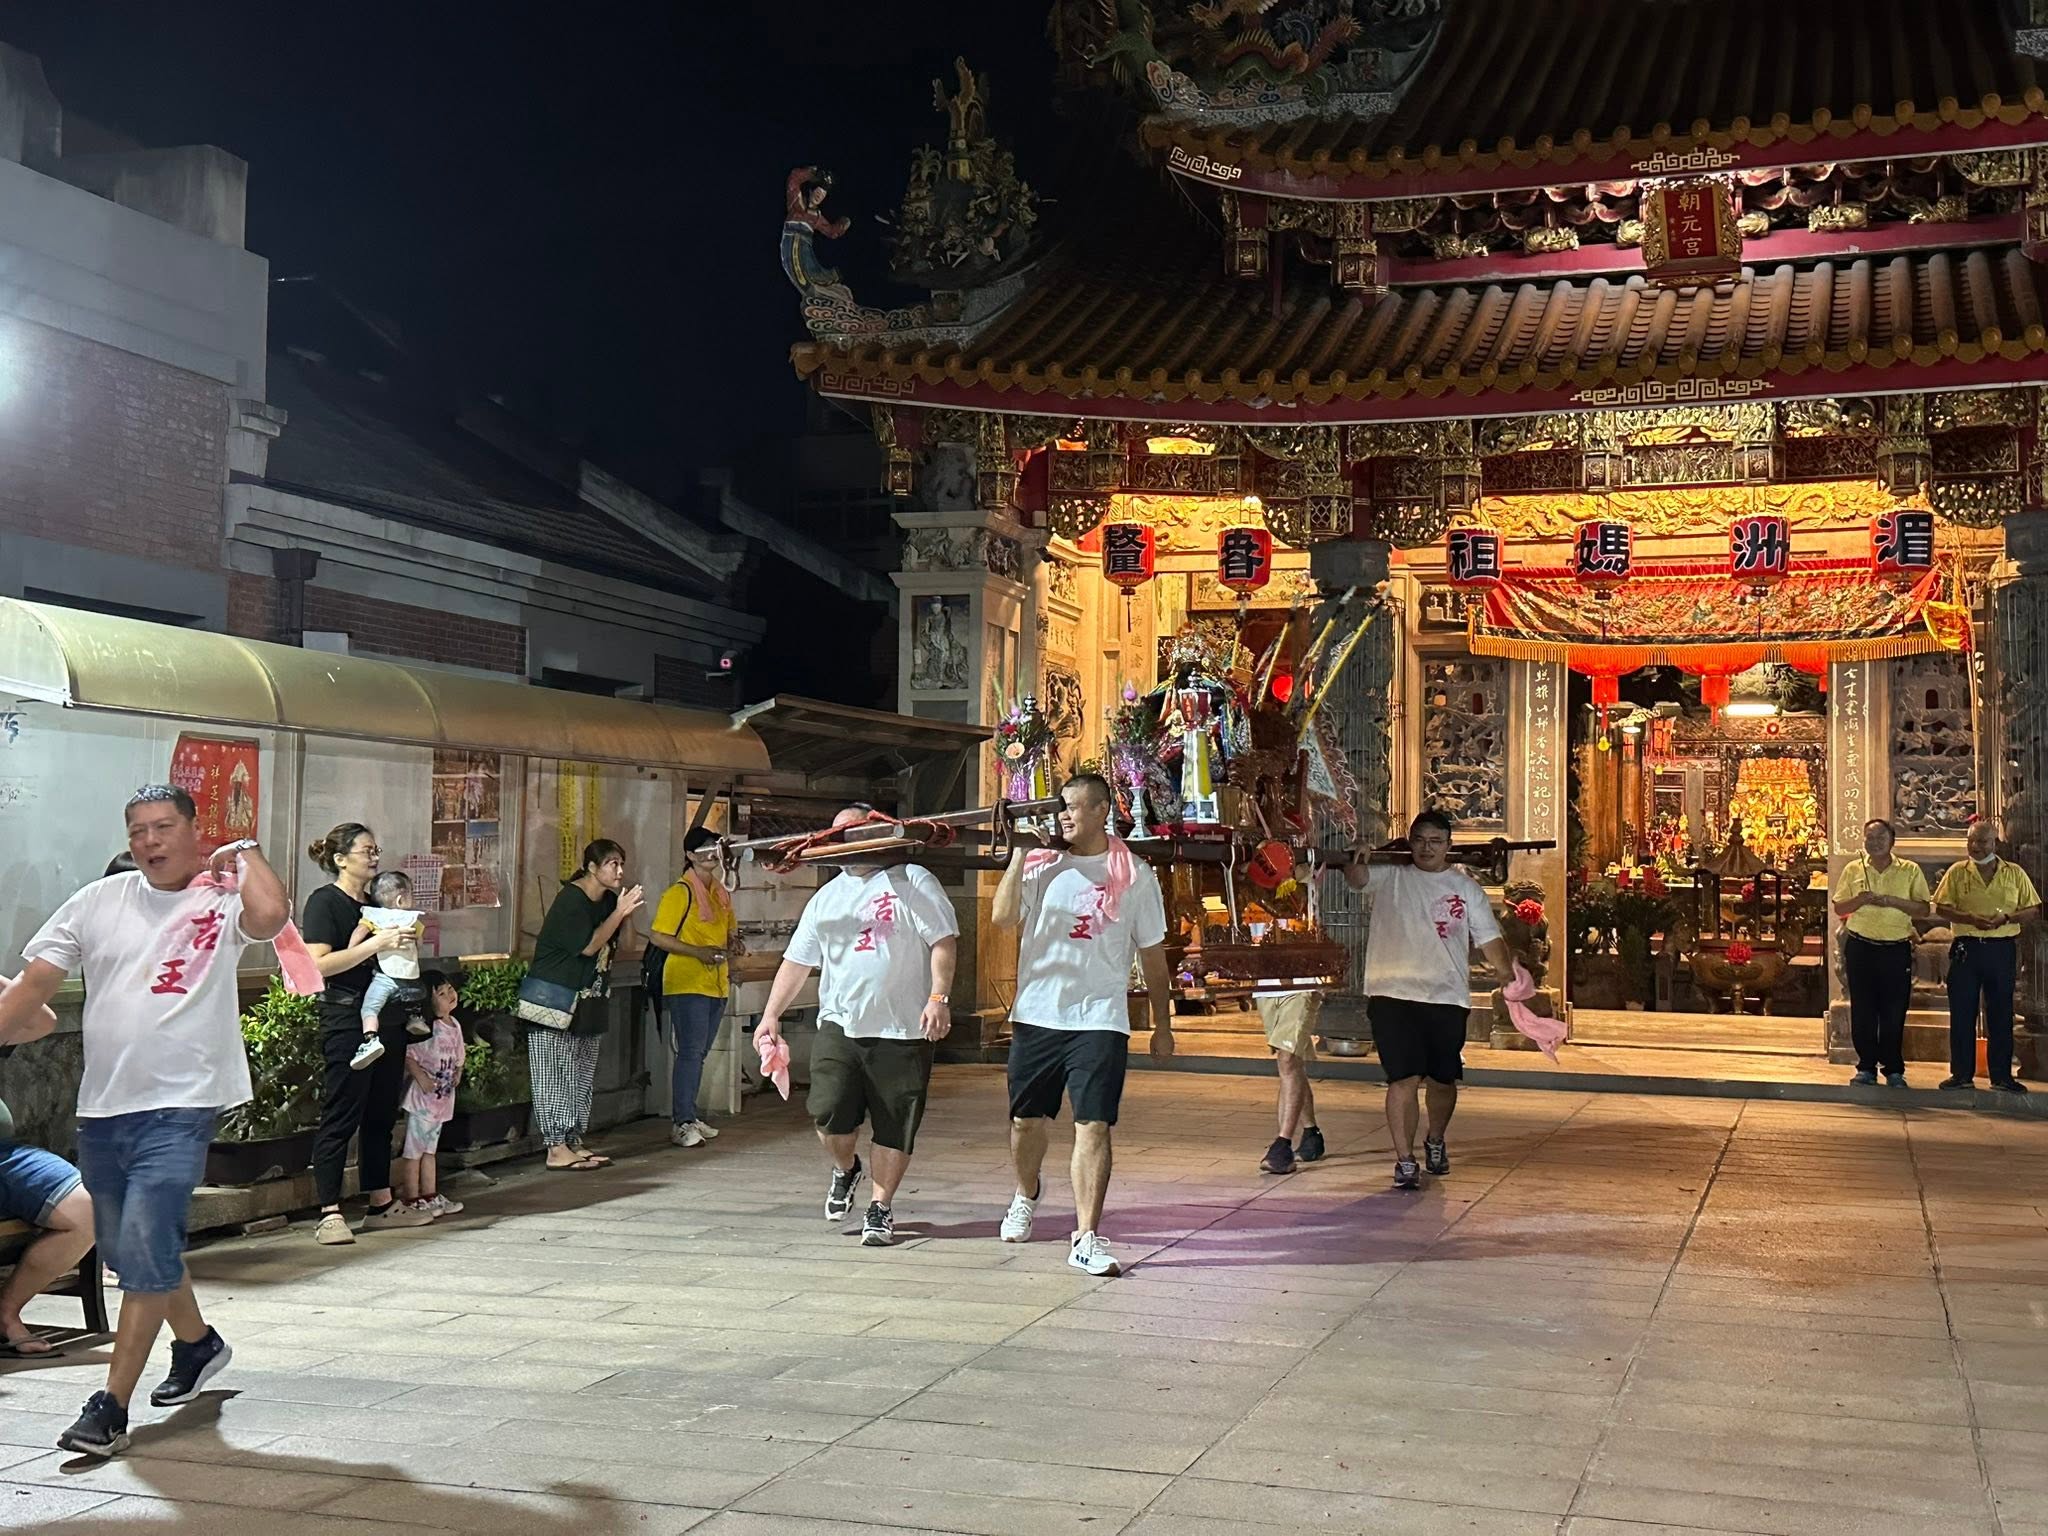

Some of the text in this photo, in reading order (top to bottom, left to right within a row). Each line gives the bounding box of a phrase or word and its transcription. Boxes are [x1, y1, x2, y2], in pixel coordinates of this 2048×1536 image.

[1677, 191, 1702, 256] 朝元宮
[1450, 513, 1934, 580] 湄 洲 媽 祖
